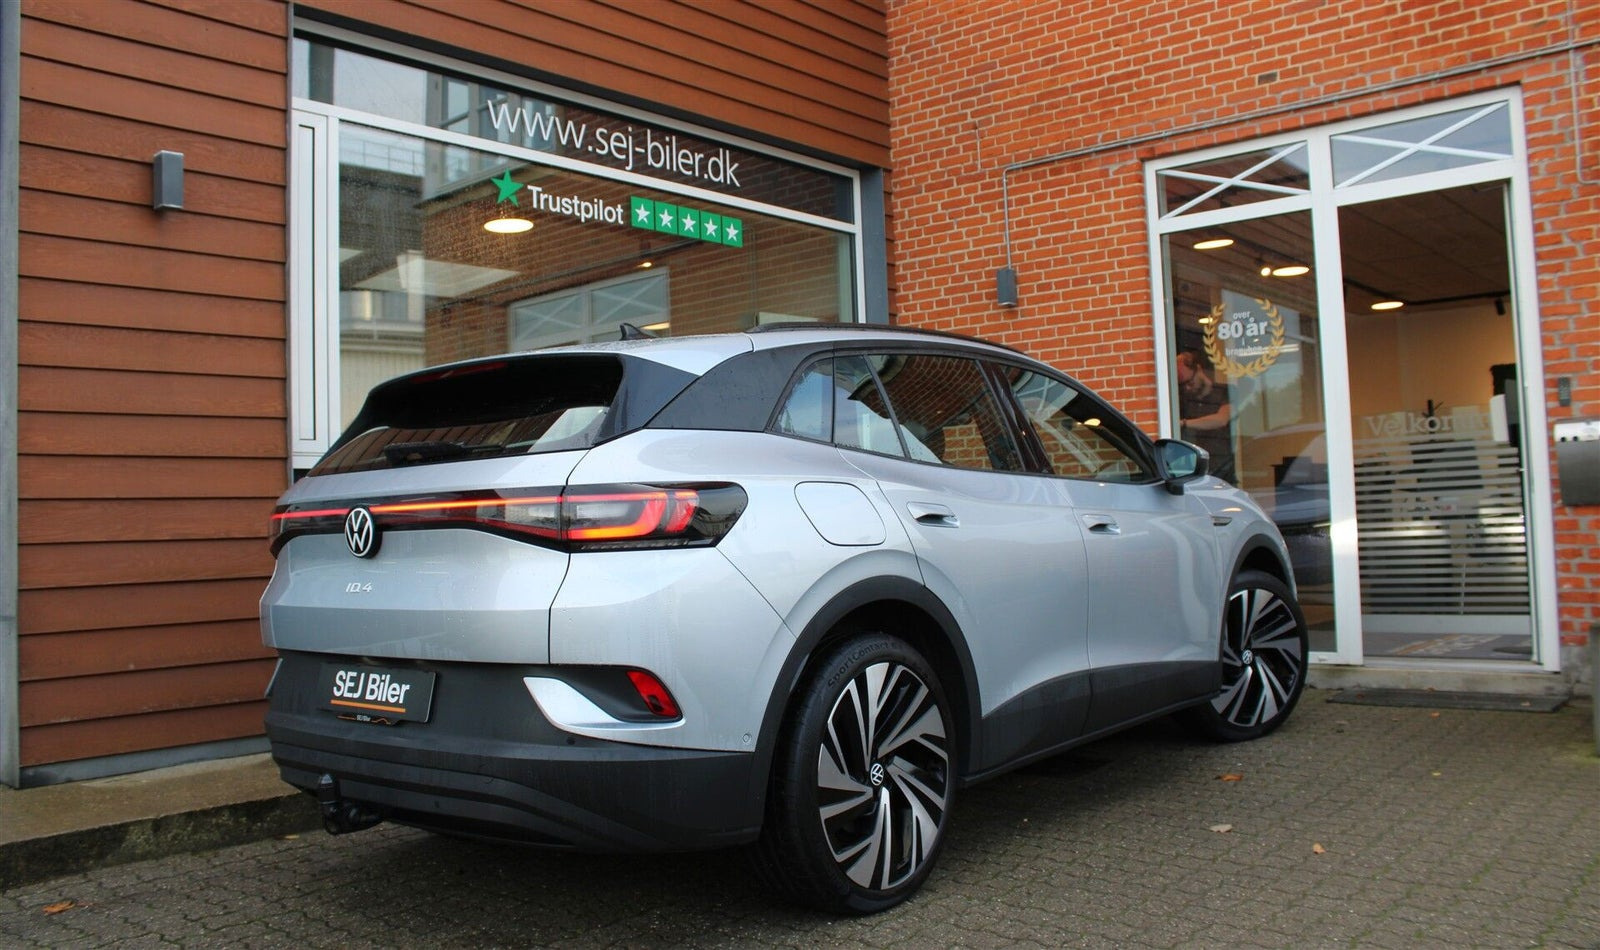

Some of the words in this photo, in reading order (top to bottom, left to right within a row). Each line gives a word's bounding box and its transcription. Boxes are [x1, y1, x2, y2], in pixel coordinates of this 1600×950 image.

[487, 100, 741, 188] www.sej-biler.dk
[527, 184, 624, 226] Trustpilot
[1218, 320, 1243, 340] 80
[1246, 318, 1267, 336] år
[1233, 311, 1250, 320] over
[333, 670, 364, 698] SEJ
[365, 673, 411, 704] Biler
